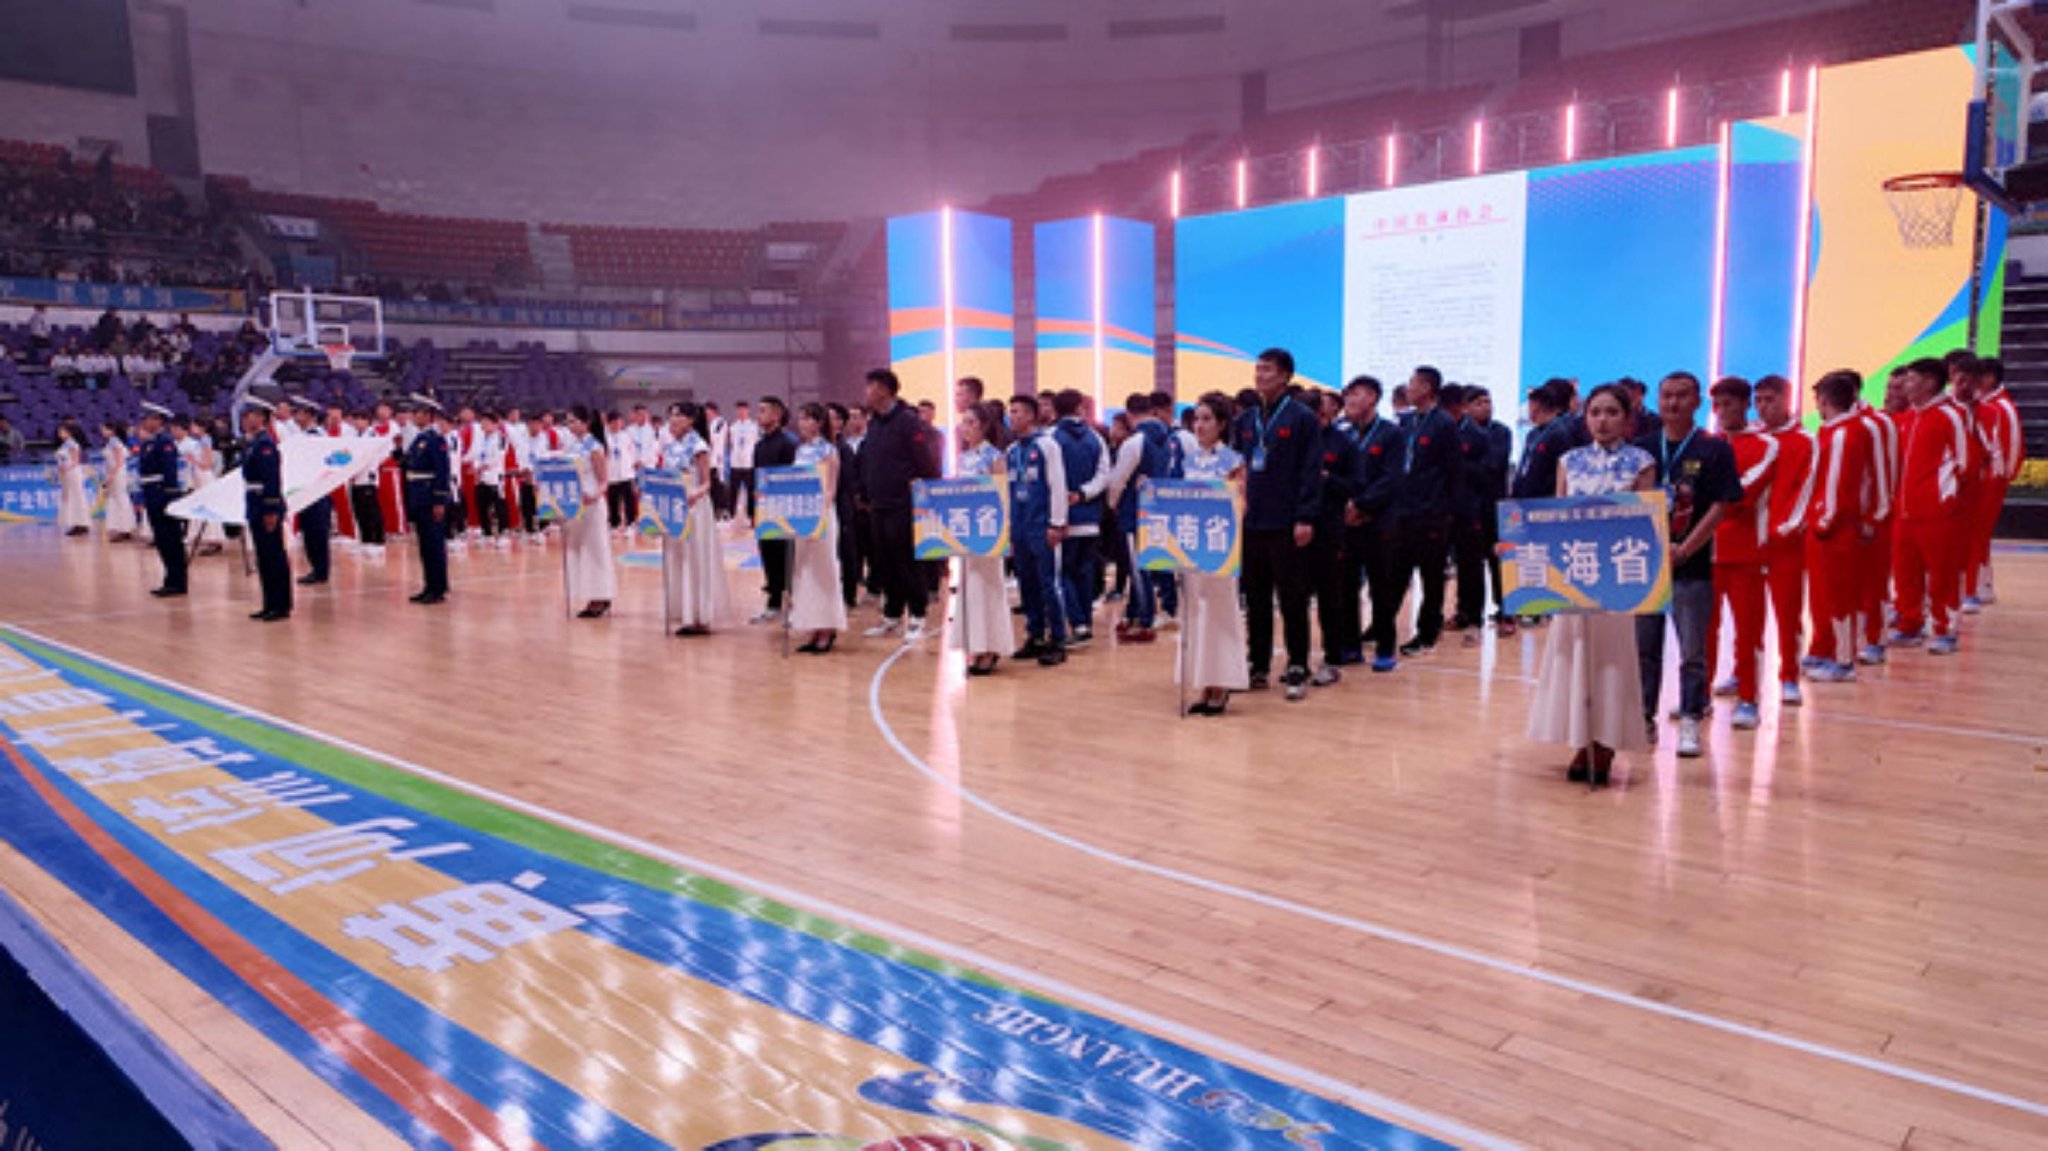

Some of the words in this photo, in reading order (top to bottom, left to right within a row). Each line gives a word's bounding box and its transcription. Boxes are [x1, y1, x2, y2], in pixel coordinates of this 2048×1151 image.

[921, 504, 998, 539] 山西省
[1147, 513, 1230, 553] 河南省
[1514, 535, 1650, 589] 青海省
[972, 1003, 1207, 1100] HUANGHE
